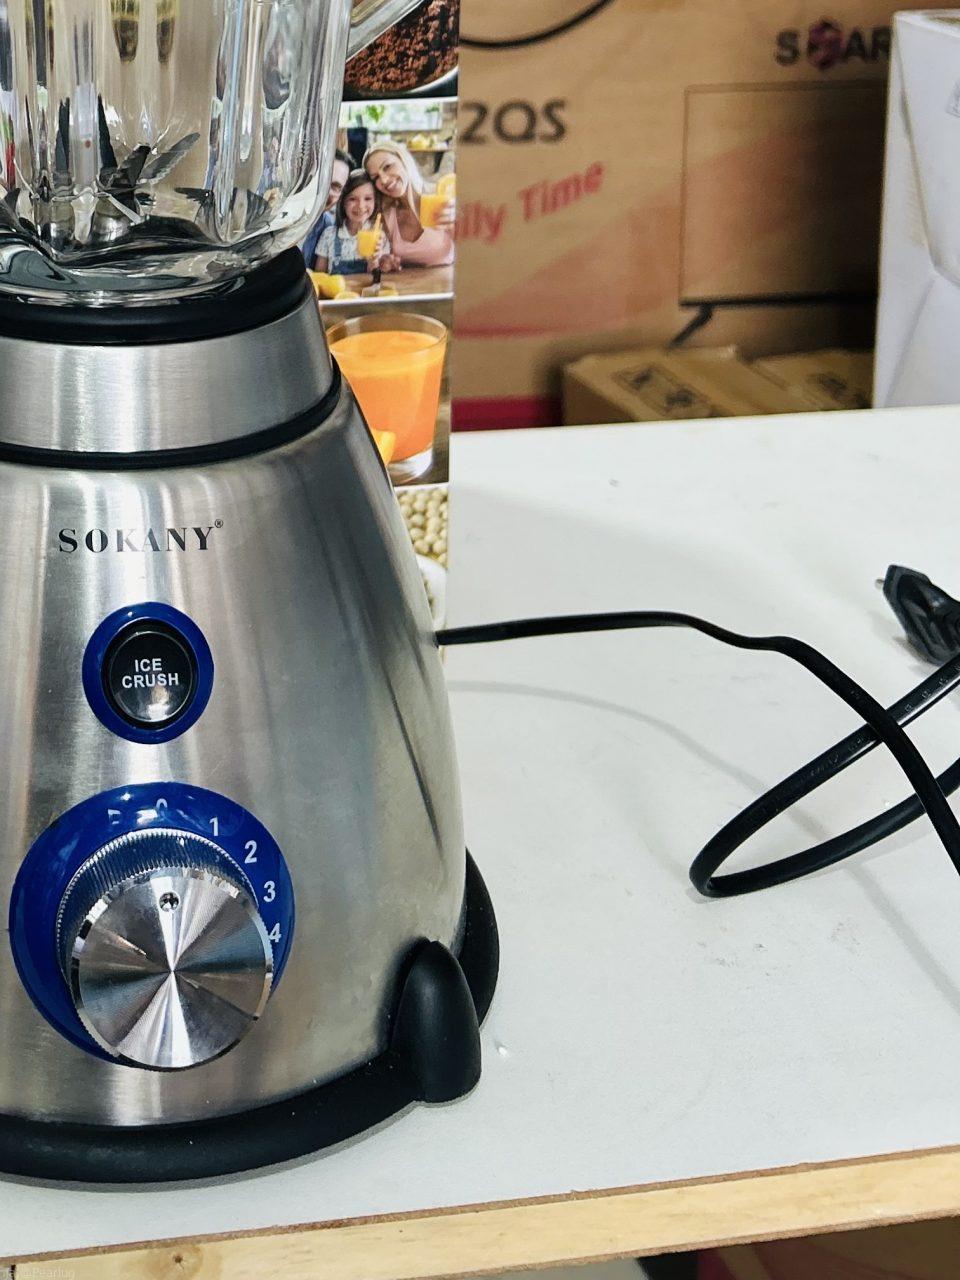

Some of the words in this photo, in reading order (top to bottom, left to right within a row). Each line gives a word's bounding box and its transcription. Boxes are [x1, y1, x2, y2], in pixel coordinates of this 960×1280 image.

[134, 657, 163, 673] ICE
[121, 672, 180, 688] CRUSH
[209, 816, 219, 837] 1
[244, 840, 258, 864] 2
[263, 880, 276, 903] 3
[268, 923, 282, 943] 4
